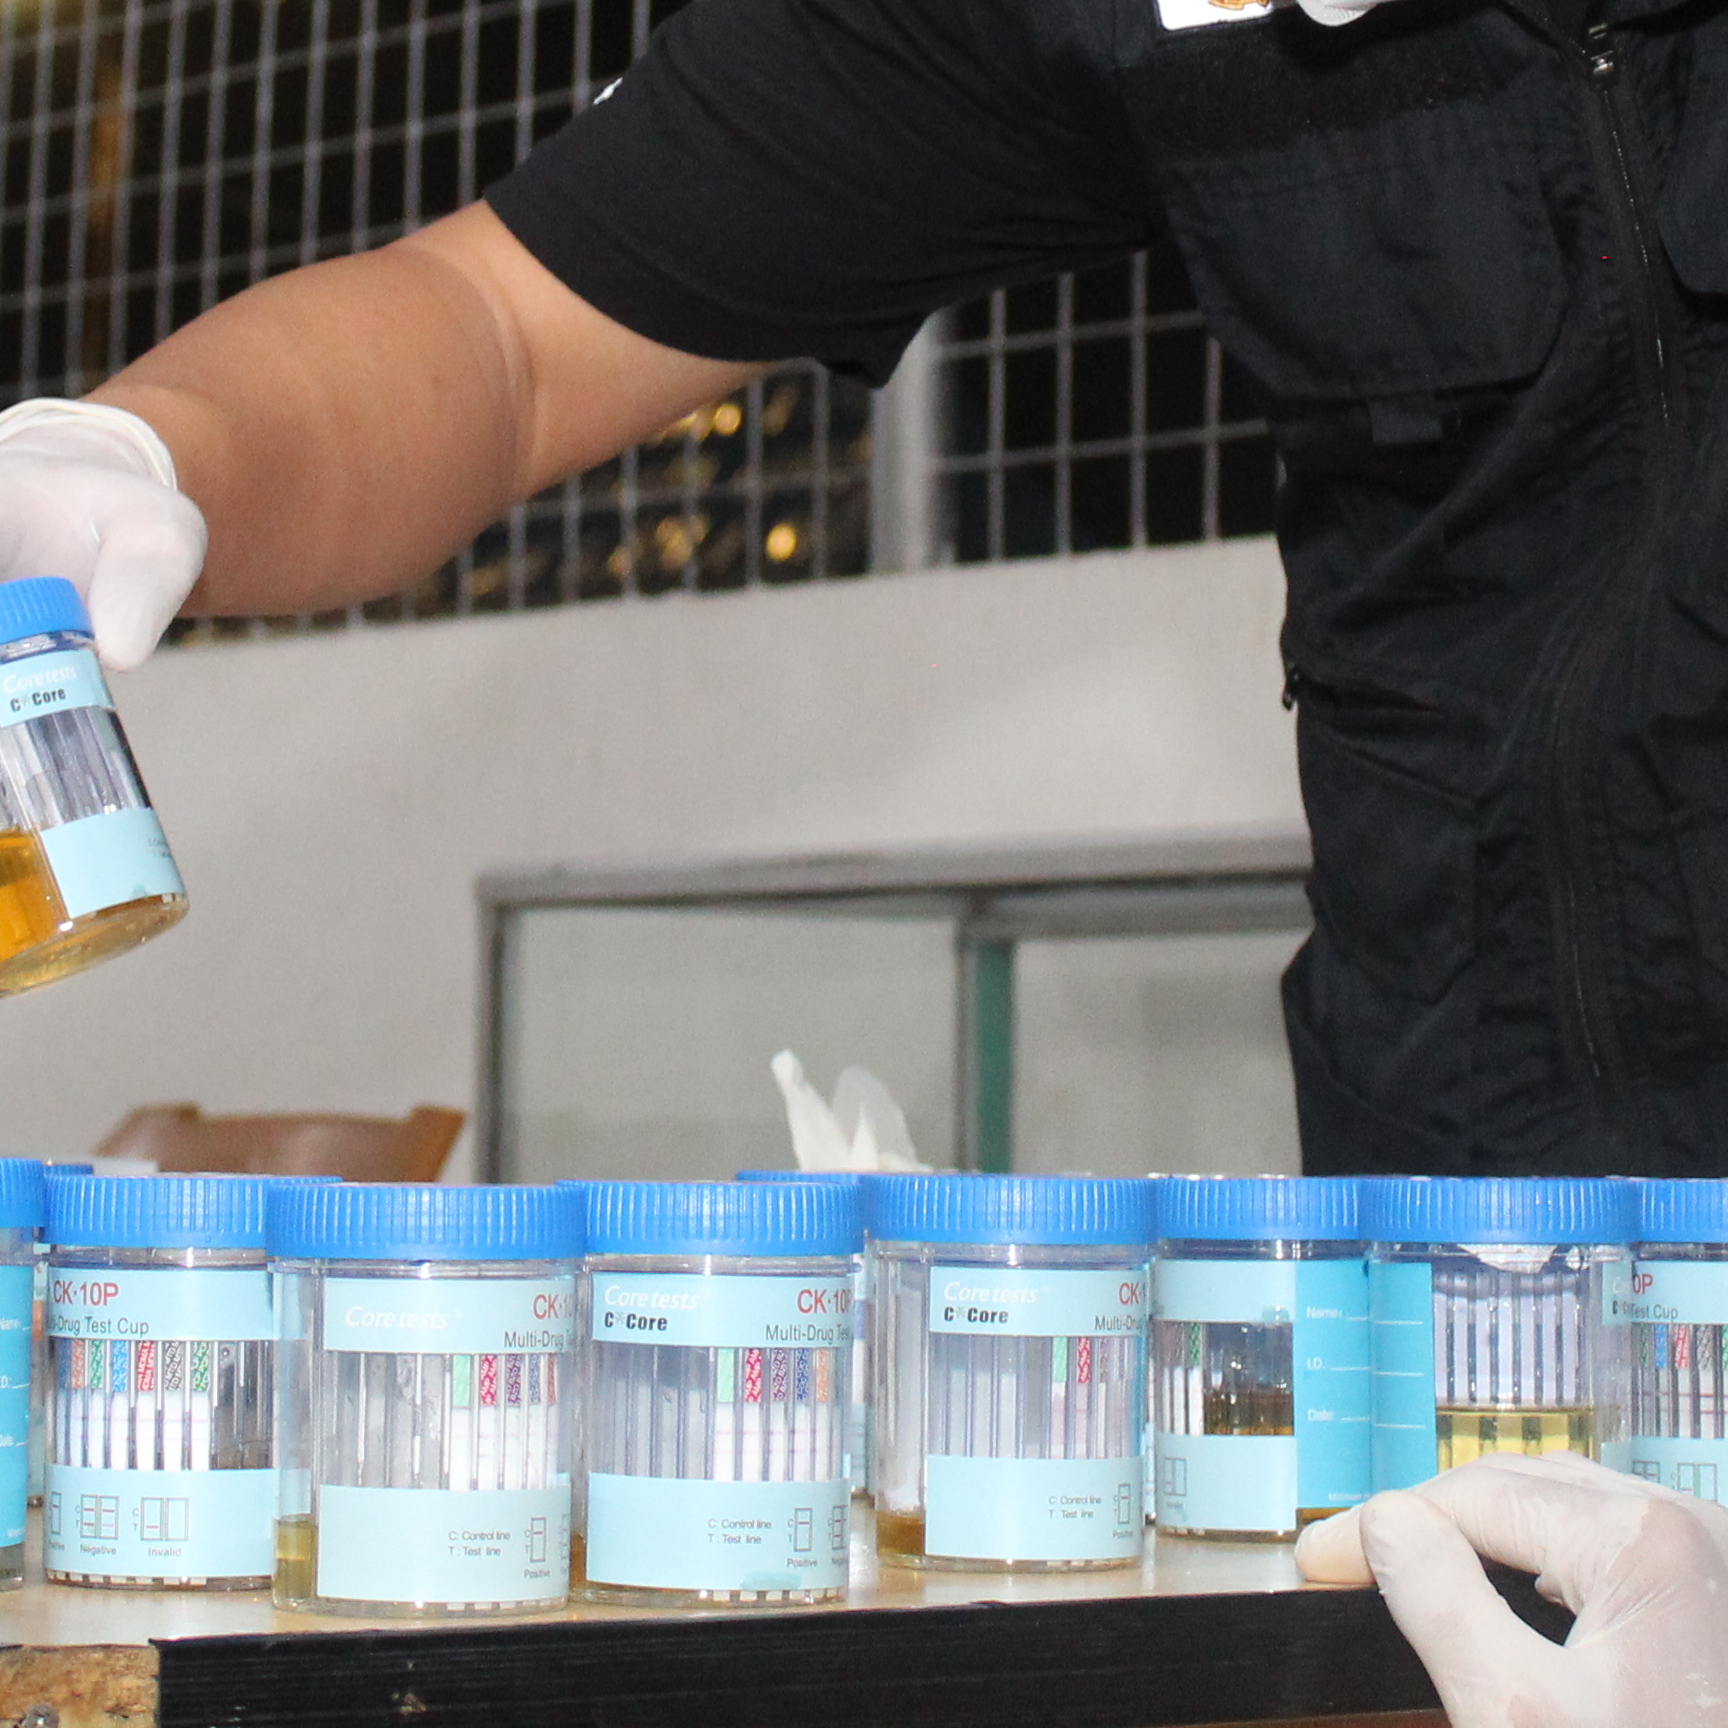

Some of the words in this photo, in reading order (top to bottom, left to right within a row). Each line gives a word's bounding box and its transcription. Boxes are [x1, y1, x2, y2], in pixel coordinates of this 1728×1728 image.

[2, 674, 44, 693] Core
[604, 1286, 647, 1307] Core
[650, 1289, 700, 1310] tests
[944, 1282, 990, 1303] Core
[992, 1285, 1038, 1304] tests
[345, 1306, 396, 1327] Core
[399, 1310, 449, 1330] tests
[967, 1307, 1009, 1324] Core
[1653, 1304, 1678, 1322] Cup
[84, 1315, 111, 1333] Test
[117, 1317, 149, 1338] Cup
[626, 1313, 668, 1331] Core
[765, 1324, 834, 1345] Multi-Drug
[1060, 1495, 1088, 1505] Control
[721, 1519, 754, 1529] Control
[756, 1520, 772, 1529] line
[462, 1531, 494, 1541] Control
[496, 1531, 511, 1541] line
[722, 1534, 741, 1544] Test
[746, 1534, 762, 1544] line
[80, 1544, 117, 1557] Negative
[148, 1547, 182, 1557] Invalid
[463, 1546, 481, 1556] Test
